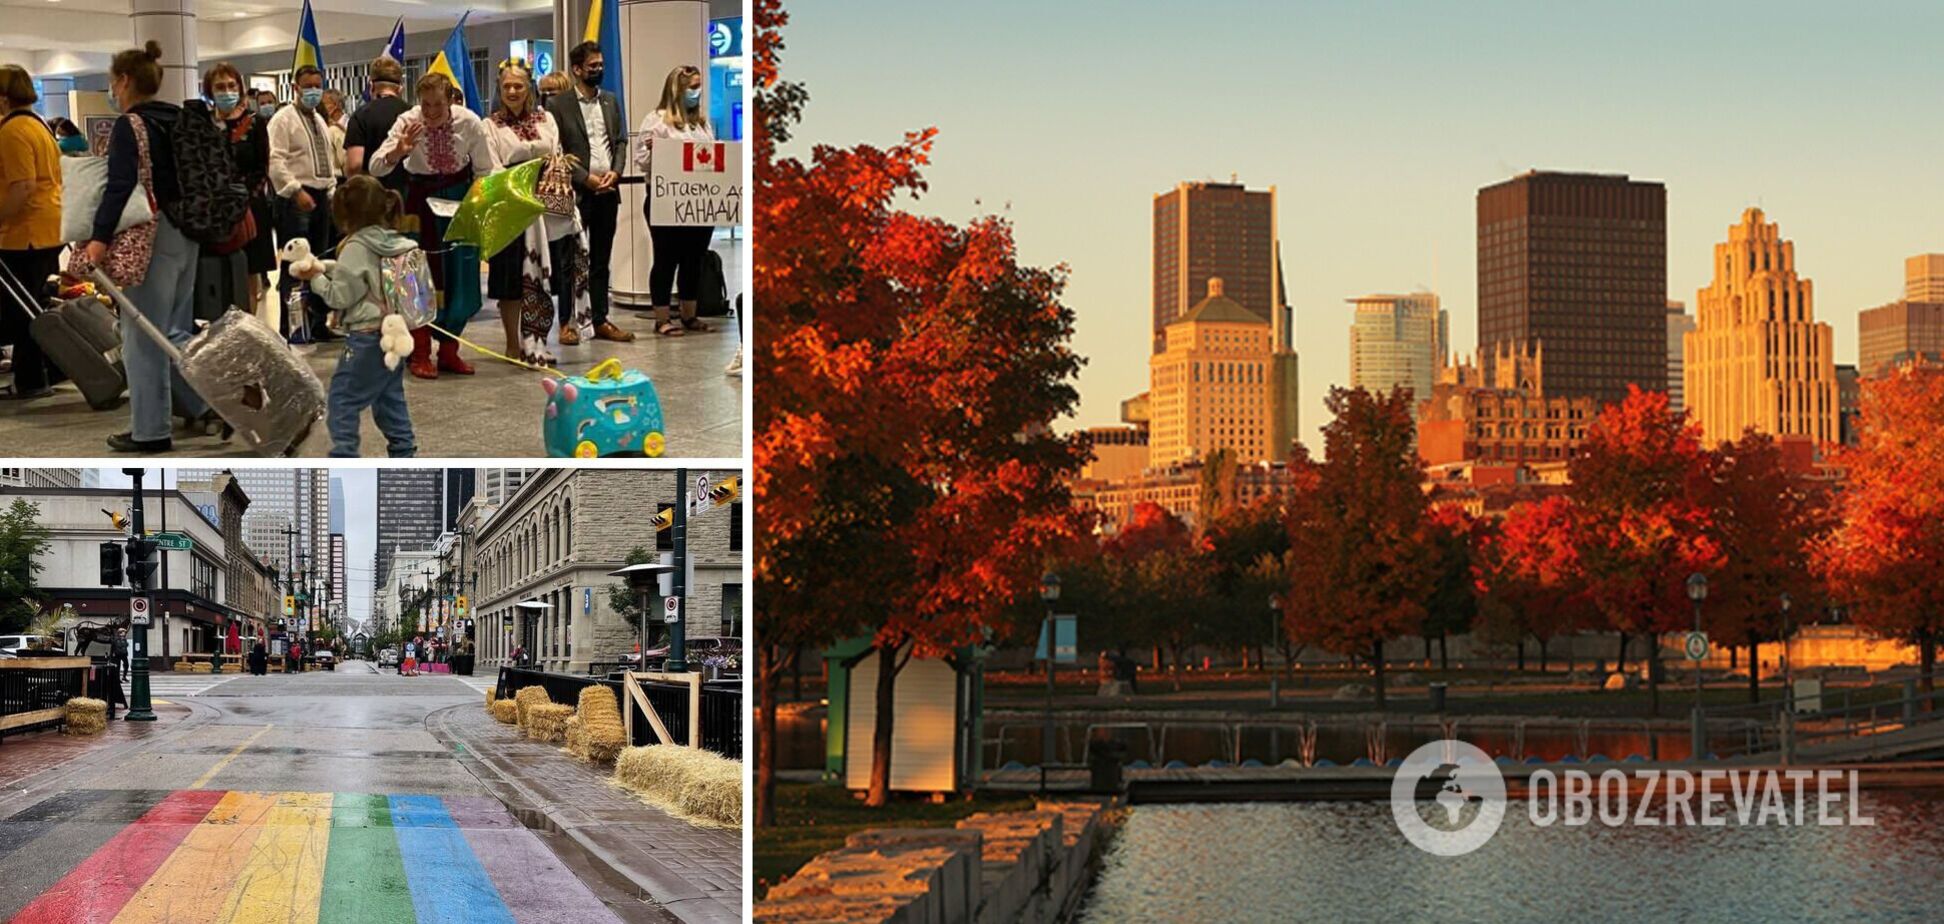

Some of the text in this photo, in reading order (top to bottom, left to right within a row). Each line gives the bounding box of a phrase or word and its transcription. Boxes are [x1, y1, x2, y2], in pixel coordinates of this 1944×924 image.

[655, 175, 721, 198] Вітаємо
[674, 198, 739, 223] КАНАДИ
[179, 540, 187, 548] ST
